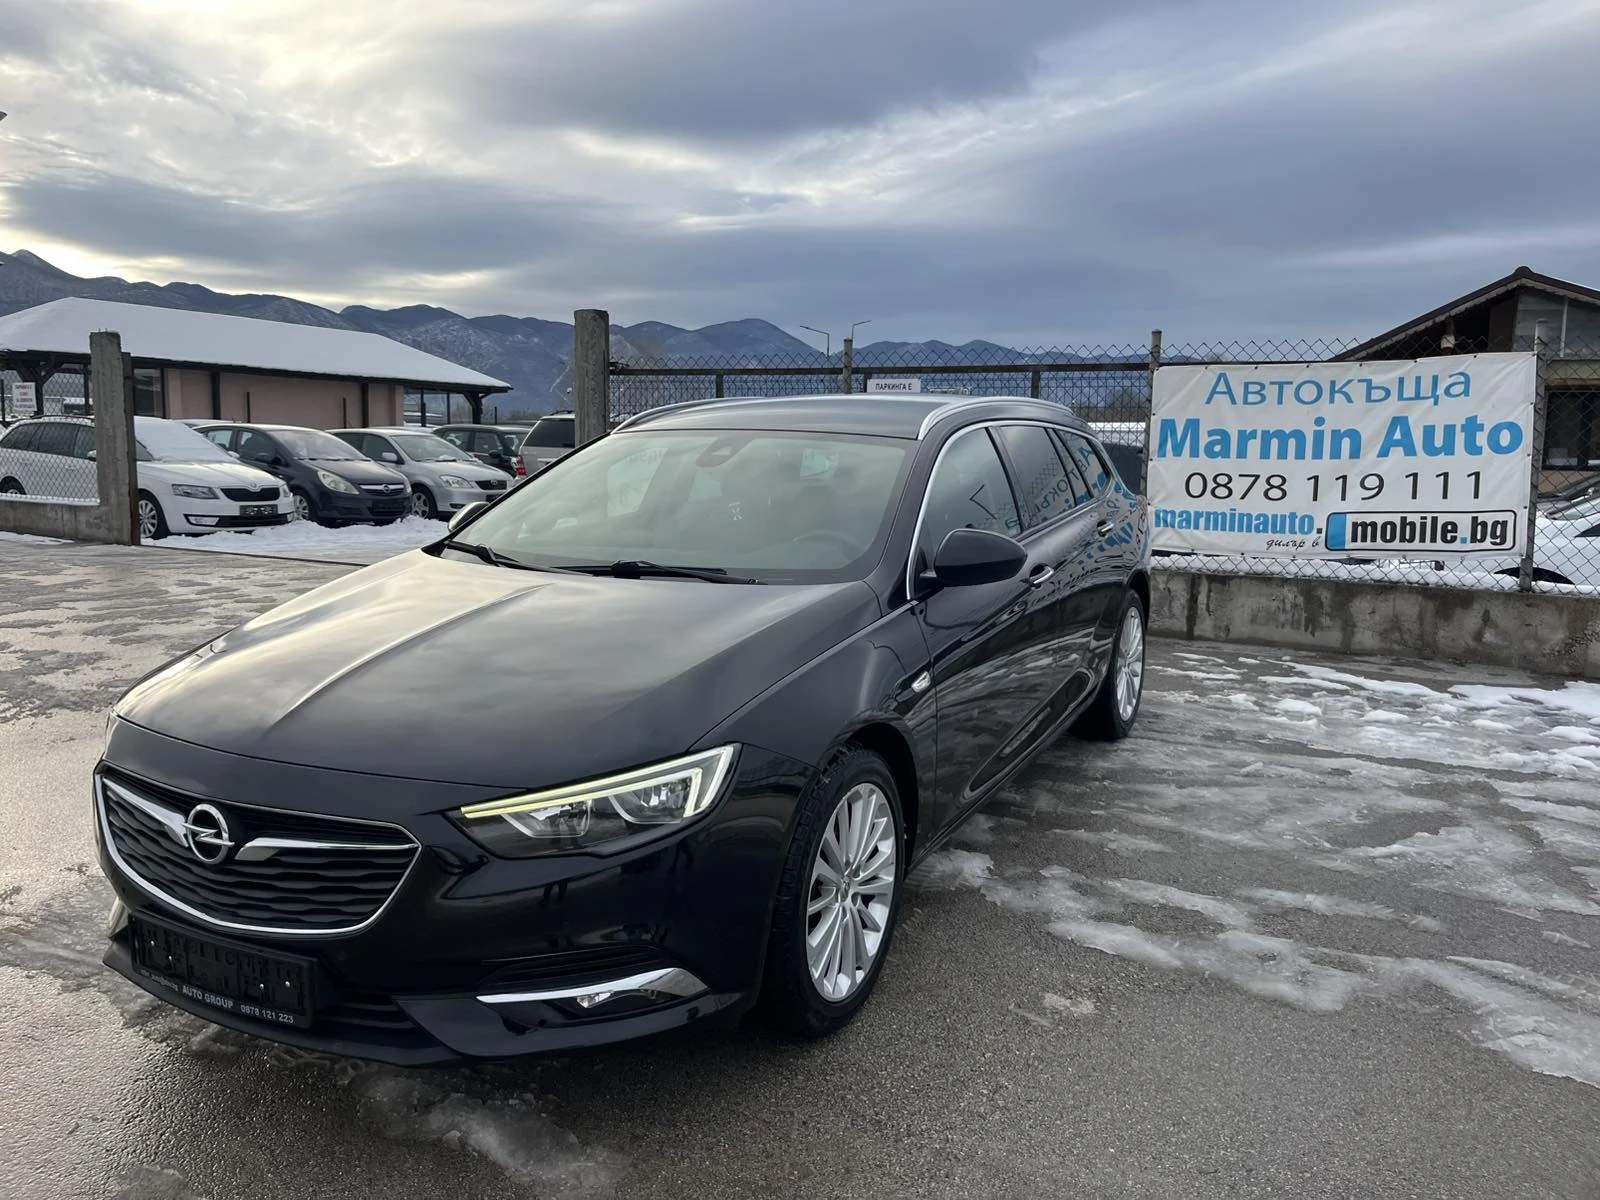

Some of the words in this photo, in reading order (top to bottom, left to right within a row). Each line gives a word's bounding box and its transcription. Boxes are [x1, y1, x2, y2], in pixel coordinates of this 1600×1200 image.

[1204, 370, 1472, 407] Автокъща
[1156, 415, 1363, 461] Marmin
[1375, 414, 1524, 458] Auto
[1184, 471, 1288, 502] 0878
[1306, 472, 1385, 502] 119
[1404, 470, 1482, 501] 111
[1350, 515, 1509, 547] mobile.bg
[182, 984, 203, 1000] AUTO
[204, 993, 234, 1009] GROUP
[262, 1009, 276, 1020] 121
